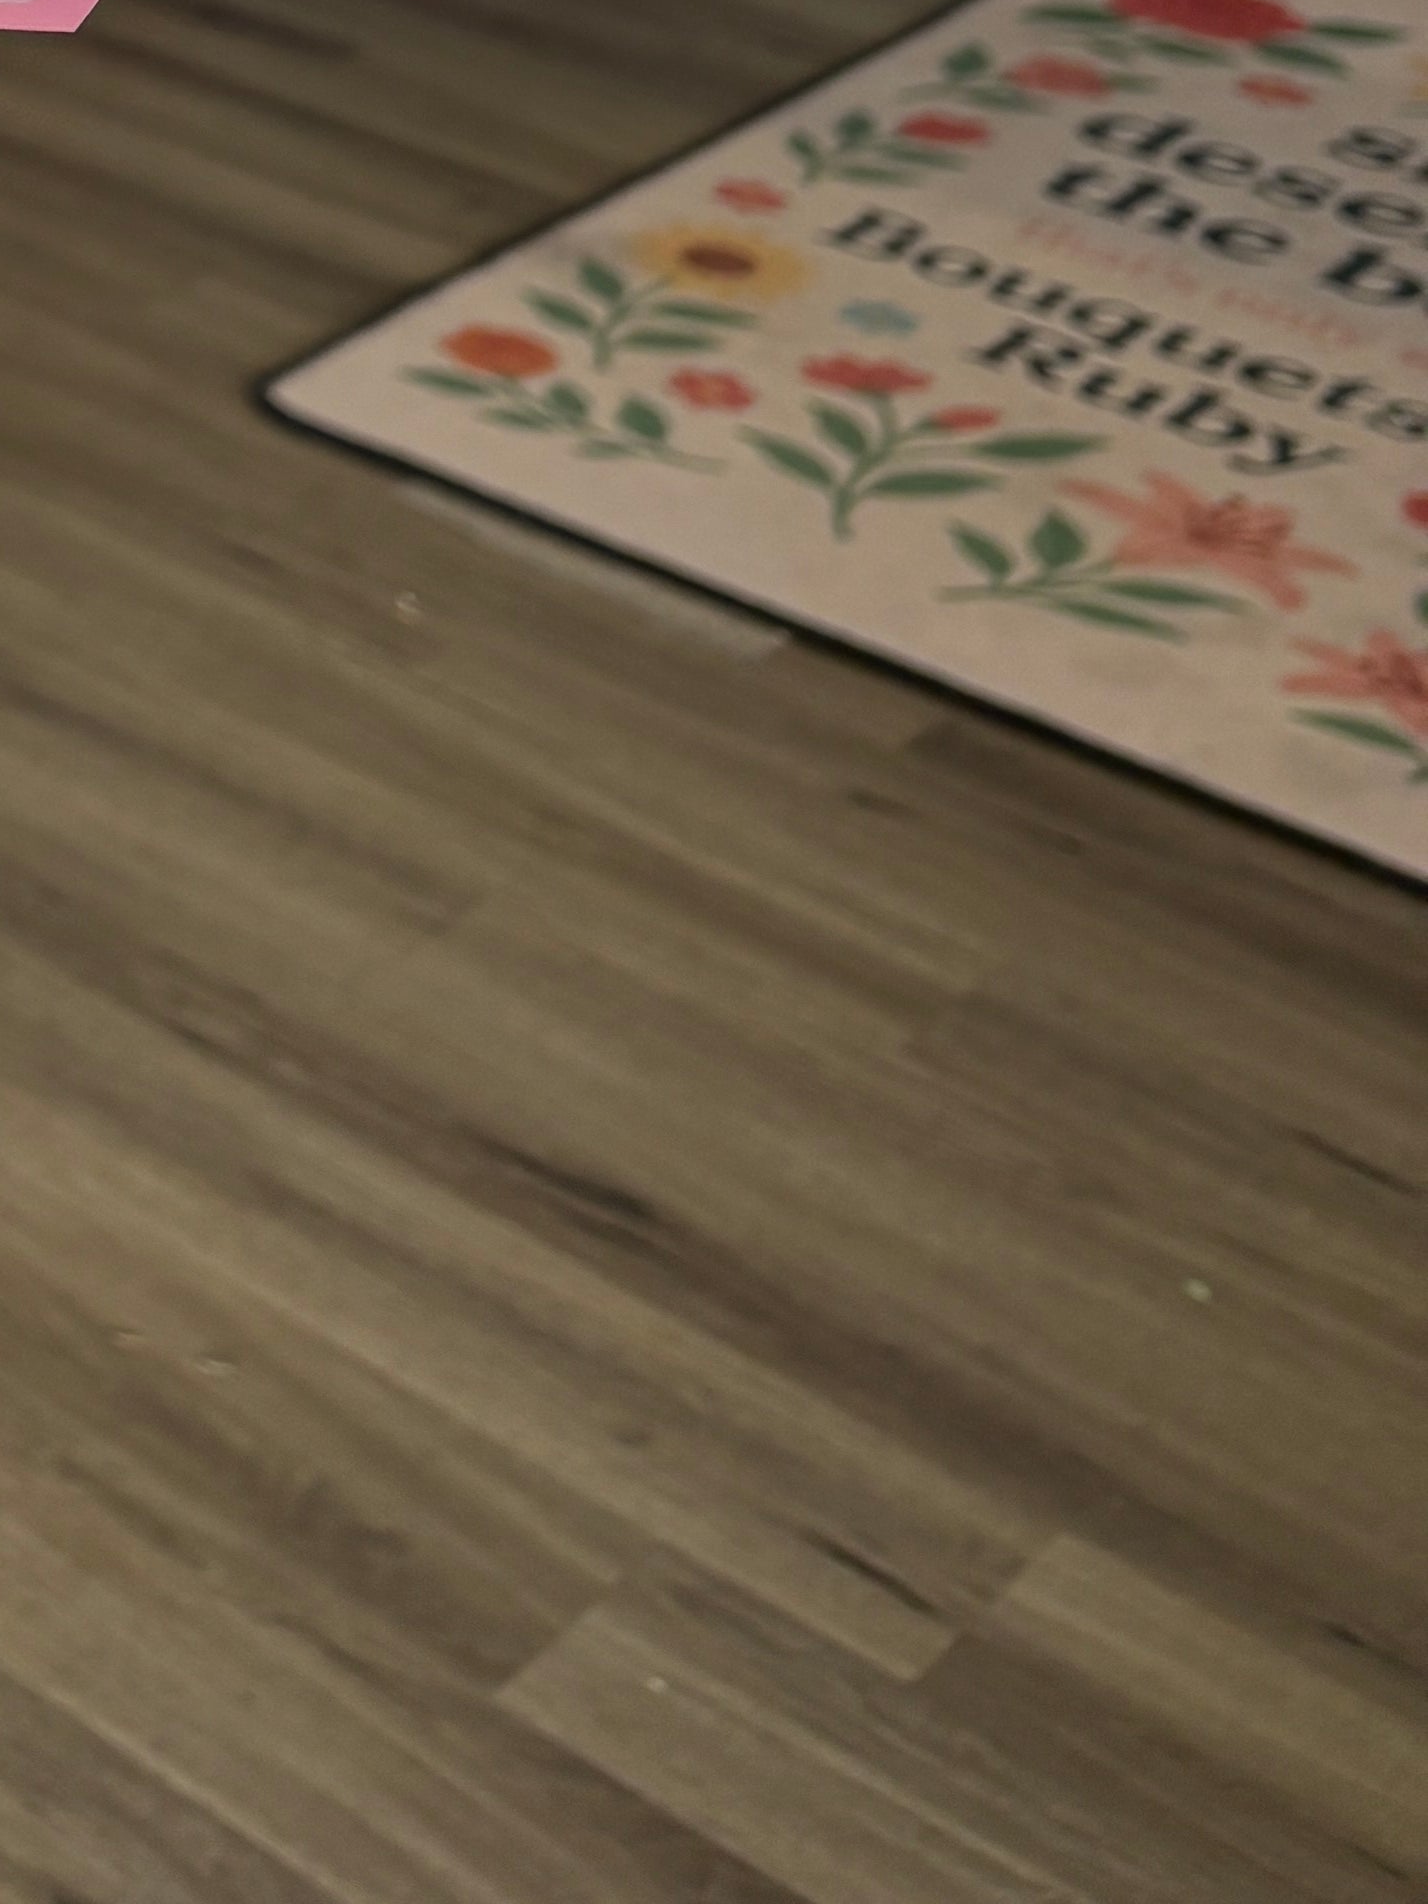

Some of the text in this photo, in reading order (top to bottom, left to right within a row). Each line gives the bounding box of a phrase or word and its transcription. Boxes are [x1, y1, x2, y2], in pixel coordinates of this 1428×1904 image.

[1041, 163, 1293, 267] the
[1074, 111, 1428, 250] dese
[812, 205, 1428, 446] Bouquets
[968, 322, 1352, 476] Ruby
